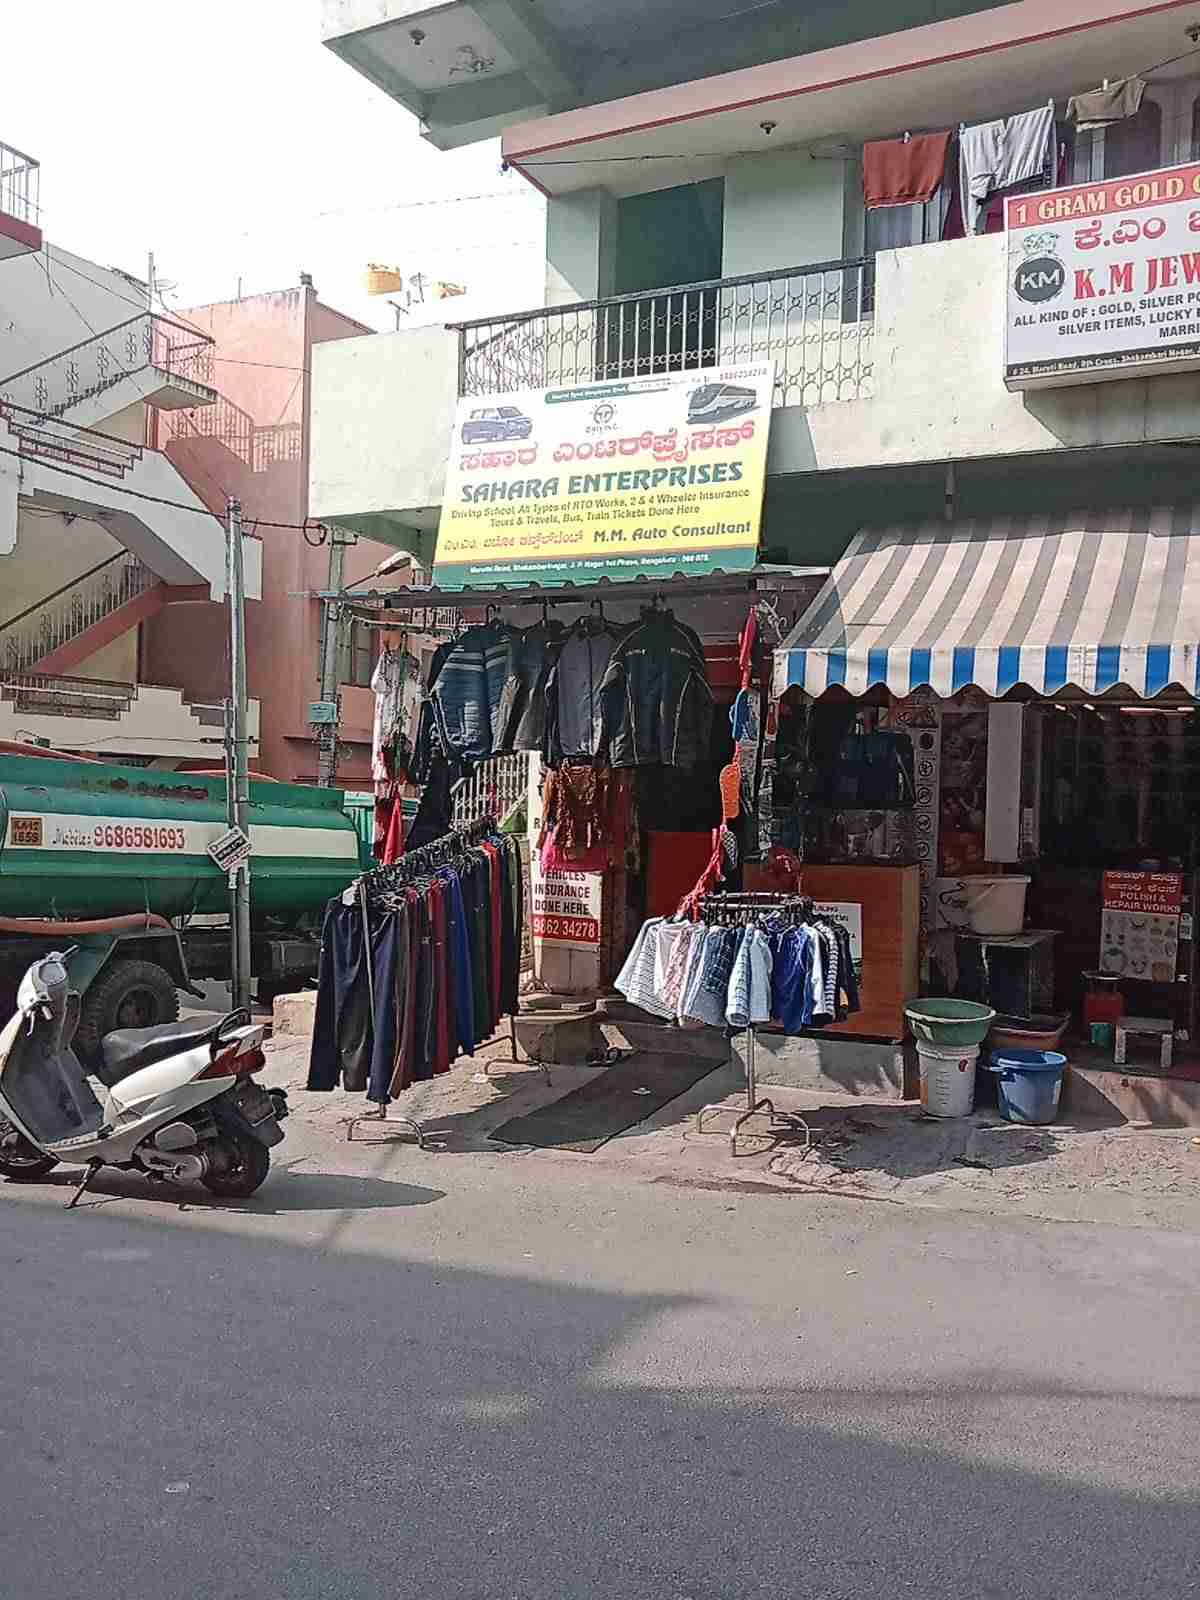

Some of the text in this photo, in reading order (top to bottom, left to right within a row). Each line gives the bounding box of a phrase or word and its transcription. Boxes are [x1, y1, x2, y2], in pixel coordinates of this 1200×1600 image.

[1016, 203, 1028, 225] 1
[1038, 190, 1106, 220] GRAM
[1115, 176, 1185, 208] GOLD
[1019, 267, 1061, 291] KM
[1073, 261, 1135, 301] K.M
[1014, 314, 1036, 328] ALL
[1039, 308, 1069, 324] KIND
[1072, 306, 1088, 320] OF
[1099, 300, 1136, 316] GOLD,
[1139, 294, 1183, 310] SILVER
[1058, 320, 1101, 336] SILVER
[1104, 314, 1146, 329] ITEMS,
[1149, 307, 1192, 323] LUCKY
[461, 461, 743, 504] SAHARA ENTERPRISES
[533, 502, 560, 514] Types
[561, 501, 571, 510] of
[630, 496, 637, 506] 2
[656, 491, 697, 504] Wheeler
[699, 488, 750, 500] Insurance
[490, 516, 515, 528] Tours
[612, 508, 646, 519] Tickets
[649, 506, 675, 517] Done
[676, 503, 700, 515] Here
[593, 520, 752, 543] M.M. Auto Consultant
[94, 824, 185, 849] 9686581693
[534, 883, 591, 899] INSURANCE
[534, 901, 590, 915] DONE HERE
